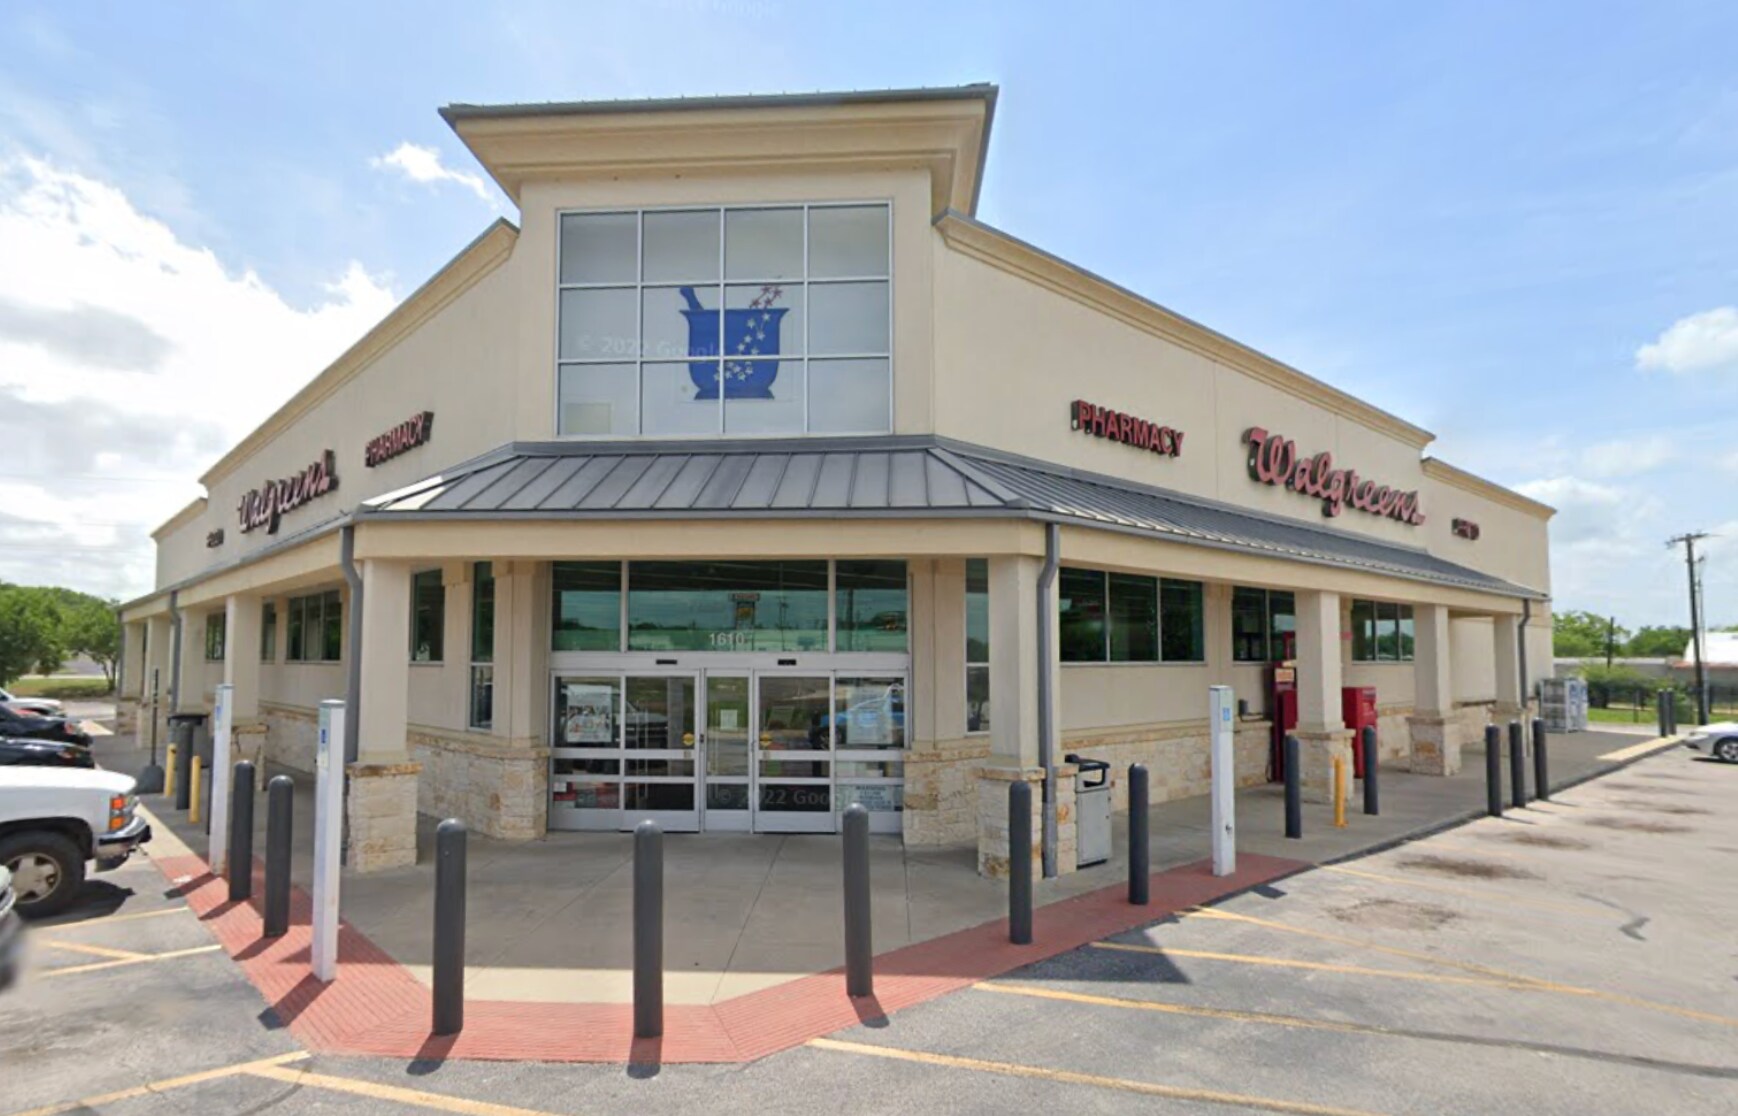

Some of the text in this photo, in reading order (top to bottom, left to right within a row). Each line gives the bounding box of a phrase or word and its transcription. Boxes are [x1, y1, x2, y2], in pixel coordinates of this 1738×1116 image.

[365, 411, 433, 468] PHARMACY
[1071, 399, 1184, 458] PHARMACY
[238, 449, 338, 534] Walgreens
[1242, 427, 1426, 527] Walgreens
[709, 631, 744, 646] 1610
